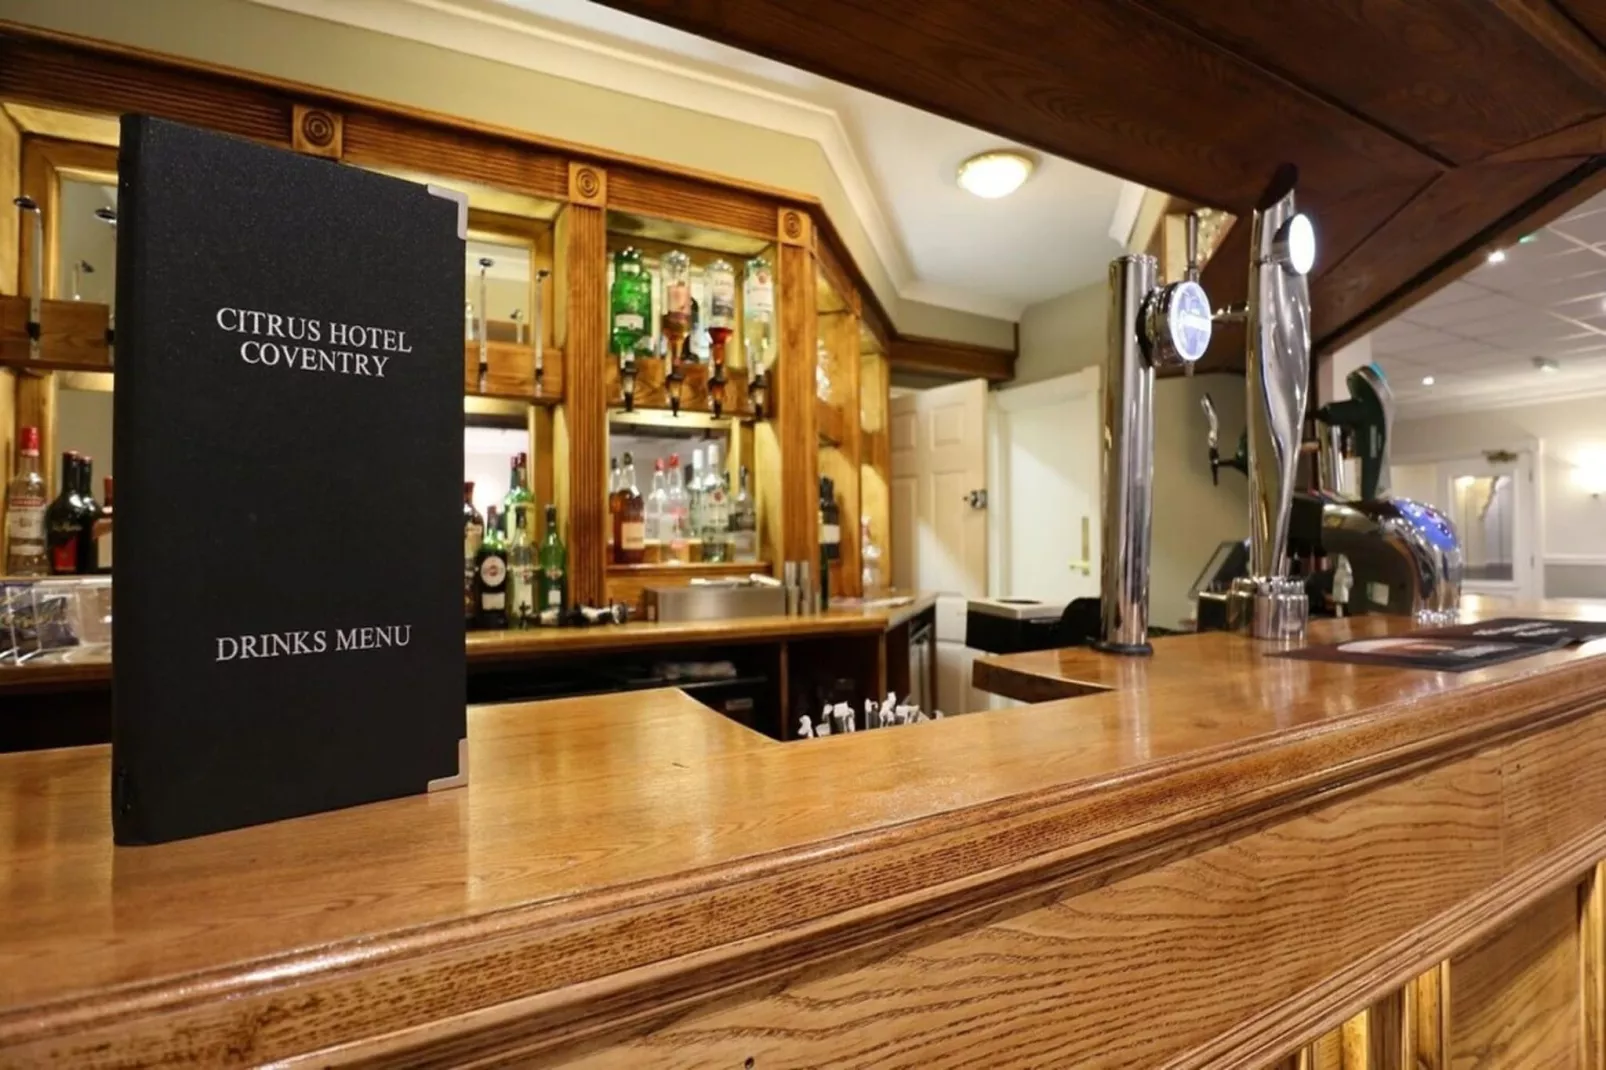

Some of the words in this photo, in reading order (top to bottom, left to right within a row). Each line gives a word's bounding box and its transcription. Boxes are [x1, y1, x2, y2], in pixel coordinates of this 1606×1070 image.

[215, 307, 321, 342] CITRUS
[329, 322, 413, 354] HOTEL
[240, 340, 390, 378] COVENTRY
[215, 630, 327, 661] DRINKS
[335, 624, 411, 653] MENU
